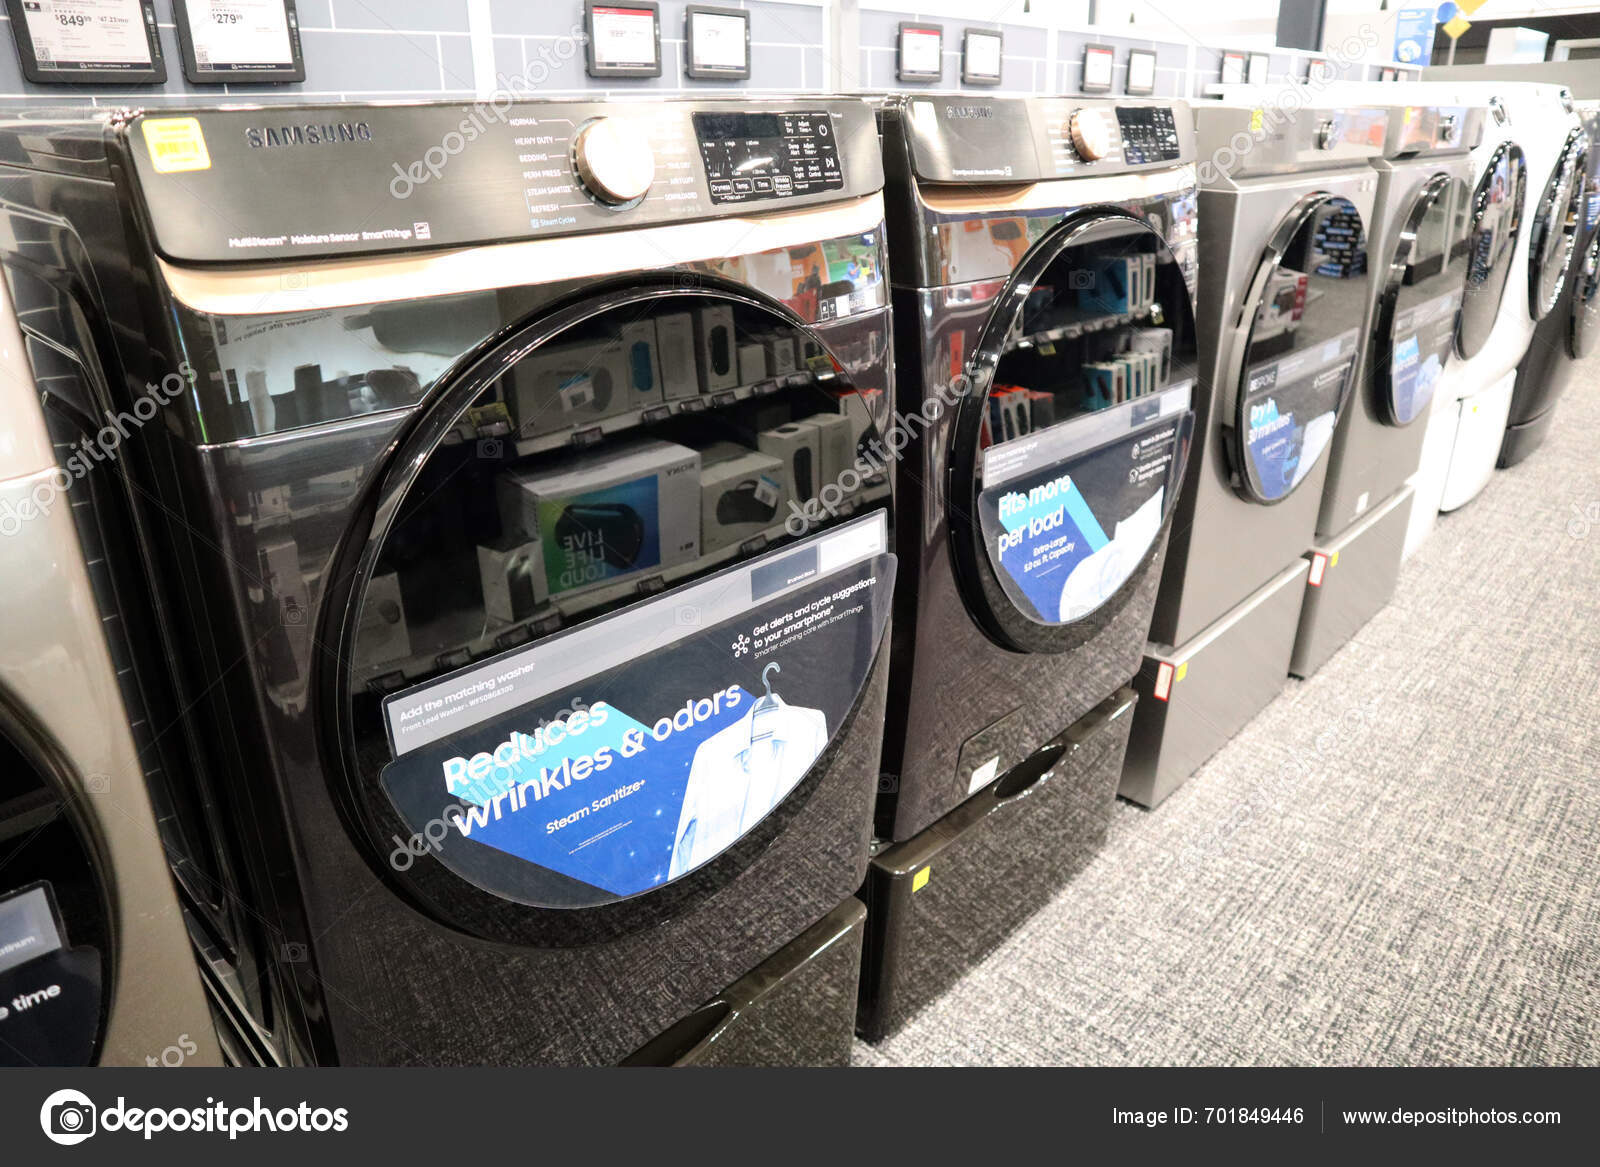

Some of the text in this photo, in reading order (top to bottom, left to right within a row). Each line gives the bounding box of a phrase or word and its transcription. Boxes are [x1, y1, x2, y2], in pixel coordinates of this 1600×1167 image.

[245, 121, 372, 148] SAMSUNG
[510, 118, 538, 126] NORMAL
[514, 136, 553, 145] HEAVY DUTY
[712, 184, 730, 192] Dryness
[540, 216, 576, 227] Steam Cycles
[290, 234, 329, 245] Moisture
[329, 233, 359, 242] Sensor
[362, 228, 412, 240] SmartThings
[998, 474, 1071, 520] Fits more
[998, 504, 1064, 562] per load
[1033, 535, 1067, 557] Extra-Large
[1049, 542, 1075, 560] Capacity
[753, 576, 876, 636] Get alerts and cycle suggestions
[754, 604, 864, 659] Smarter clothing care with SmartThings
[754, 639, 763, 649] to
[764, 629, 782, 646] your
[400, 662, 535, 722] Add the matching washer
[402, 723, 422, 734] Front
[422, 714, 439, 726] Load
[439, 704, 465, 718] Washer
[442, 700, 609, 793] Reduces
[452, 746, 614, 837] wrinkles
[620, 728, 646, 758] &
[652, 684, 741, 742] odors
[546, 808, 590, 834] Steam
[12, 984, 61, 1011] time
